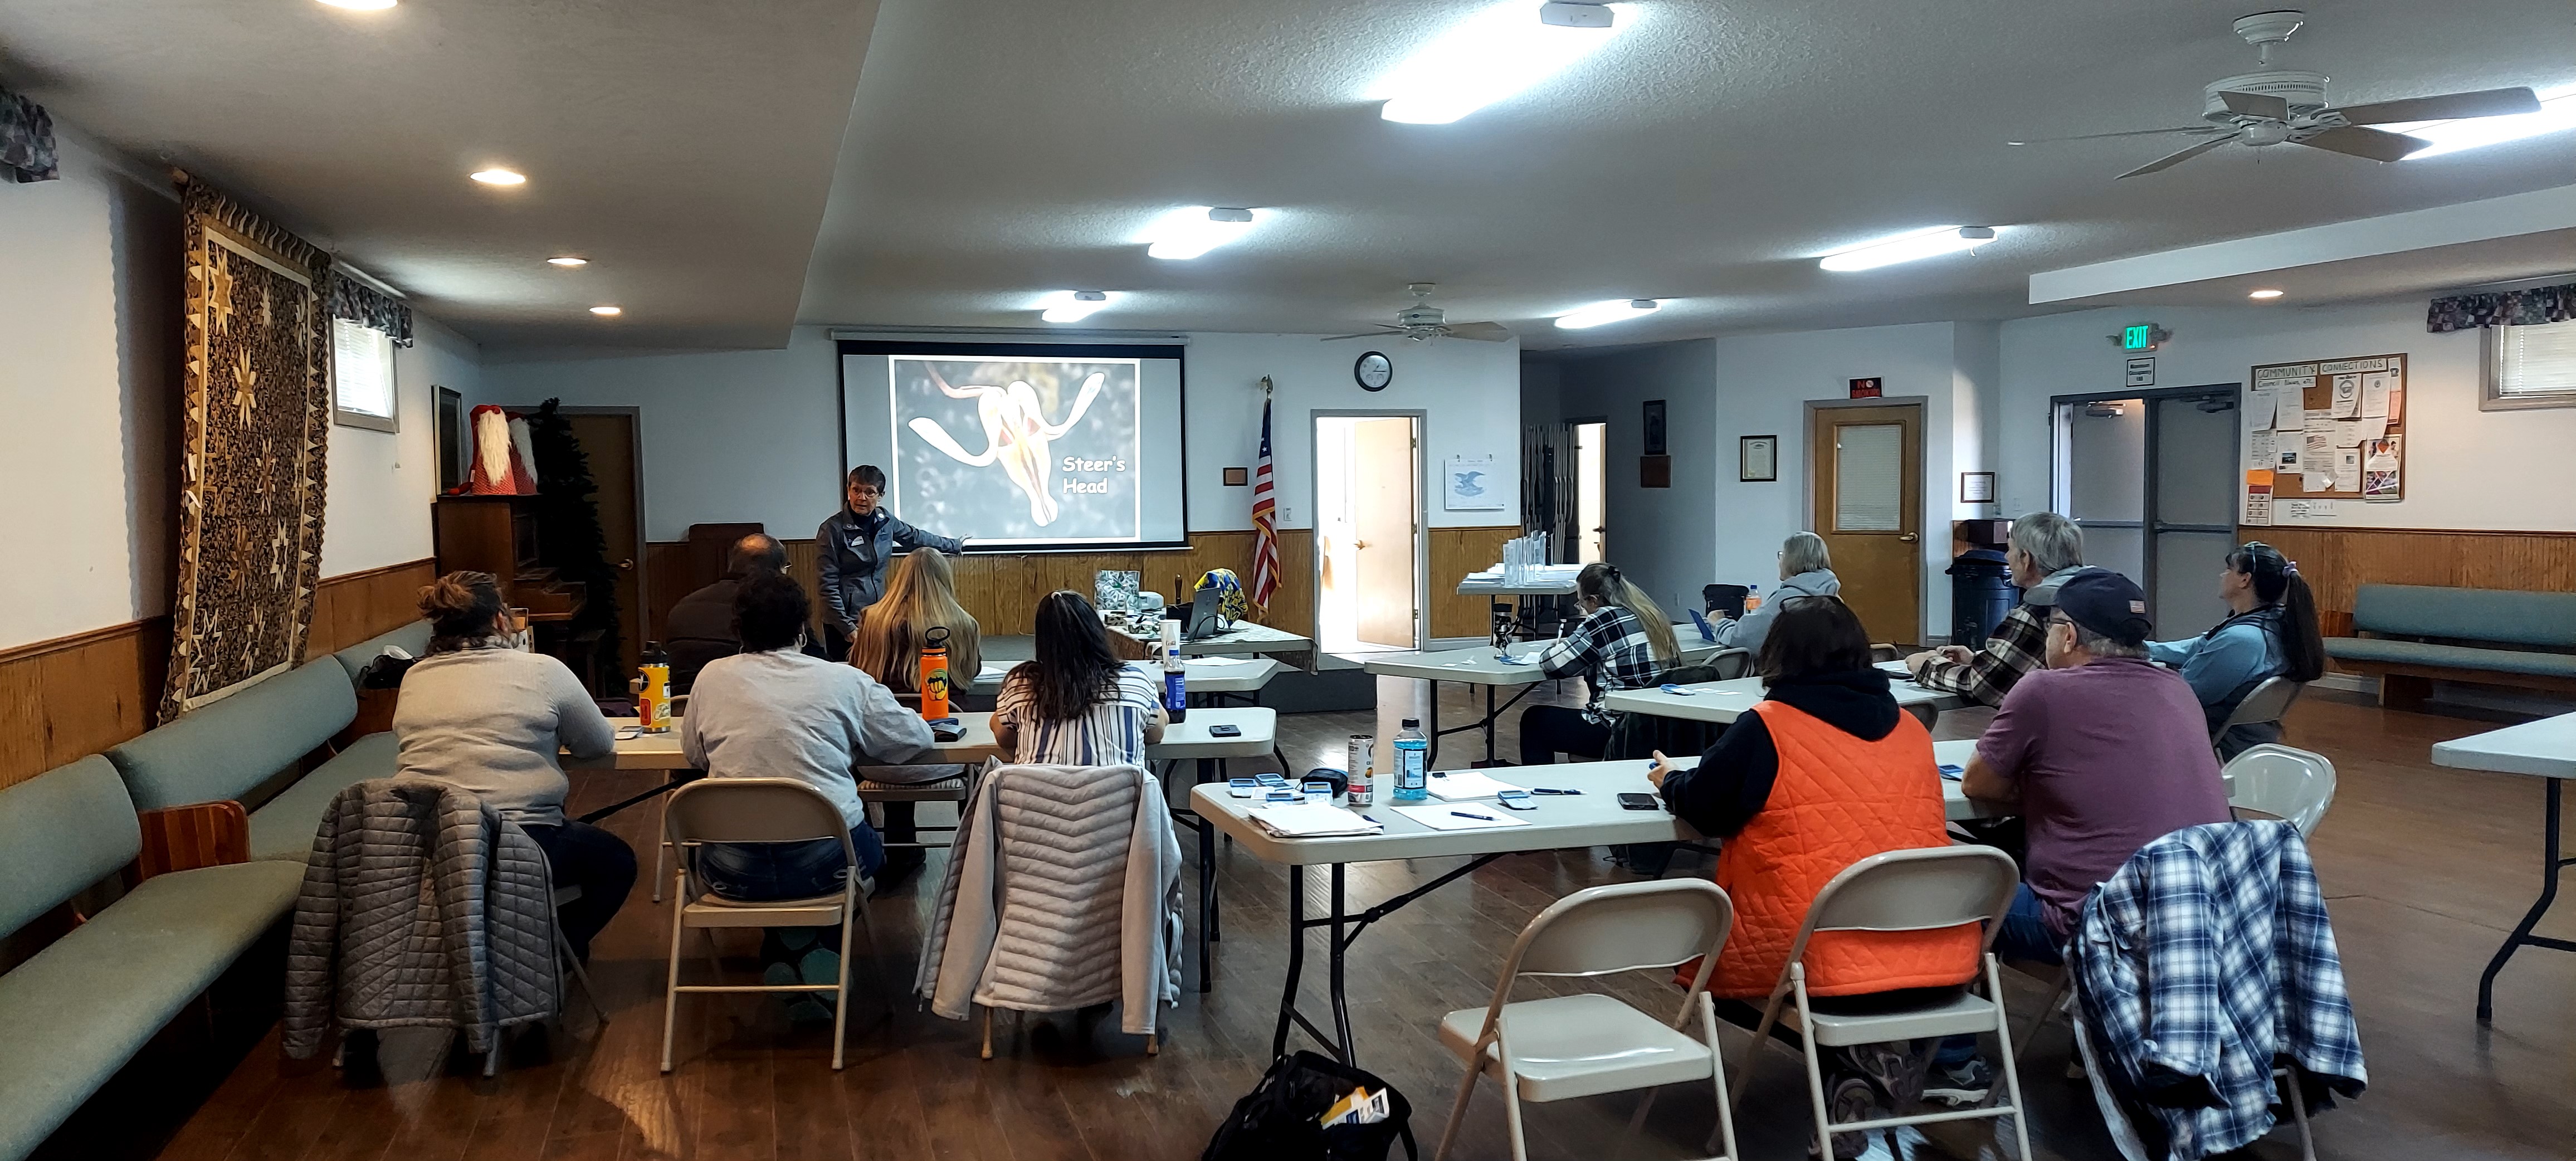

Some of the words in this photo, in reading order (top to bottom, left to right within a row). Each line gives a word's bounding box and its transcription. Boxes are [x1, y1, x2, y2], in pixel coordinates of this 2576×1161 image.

[2126, 325, 2149, 349] EXIT
[2257, 364, 2316, 378] COMMUNITY
[2322, 359, 2383, 372] CONNECTIONS
[1062, 455, 1126, 472] Steer's
[1063, 477, 1108, 494] Head
